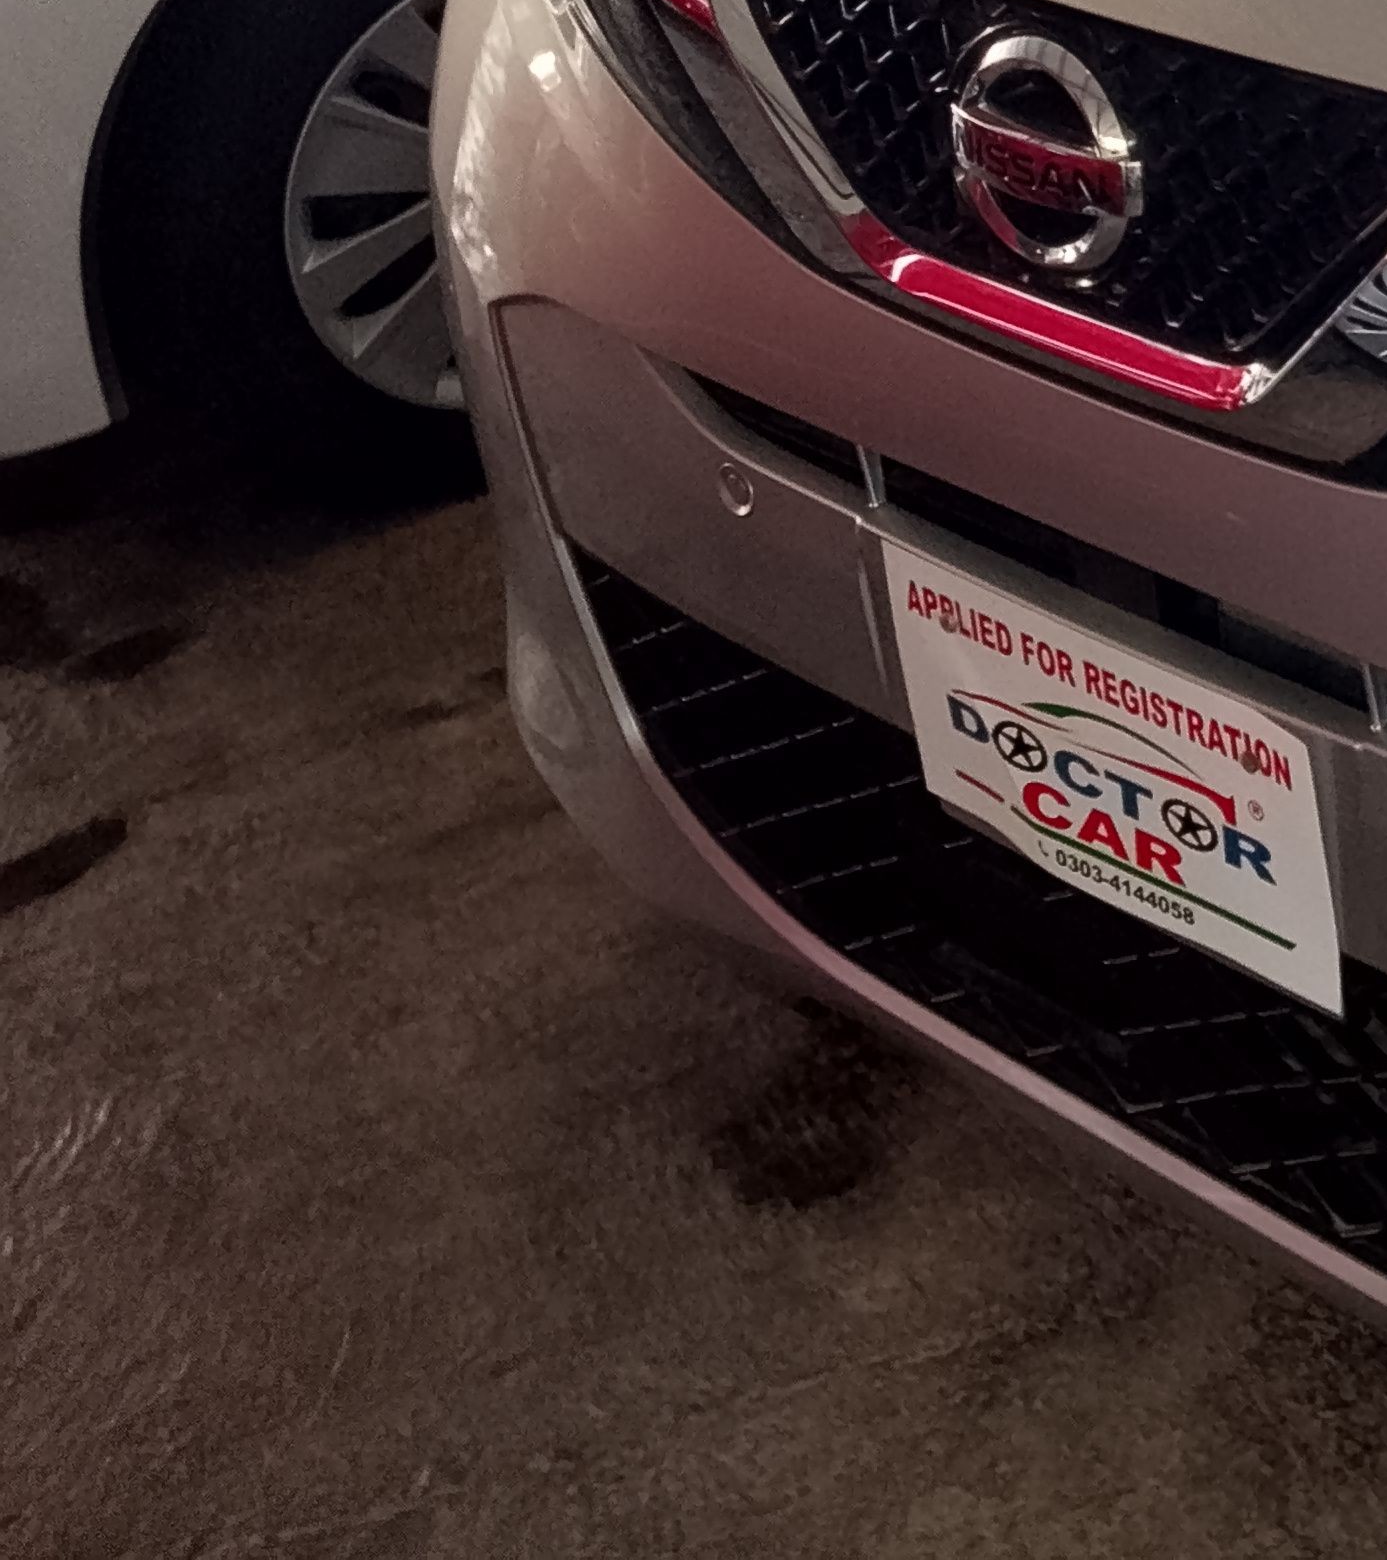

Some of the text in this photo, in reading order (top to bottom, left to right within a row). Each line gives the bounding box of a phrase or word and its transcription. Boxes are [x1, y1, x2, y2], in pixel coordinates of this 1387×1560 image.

[963, 123, 1111, 209] NISSAN
[906, 579, 1294, 792] APPLIED FOR REGISTRATION
[1021, 781, 1188, 888] CAR
[1055, 848, 1196, 926] 0303-4144058
